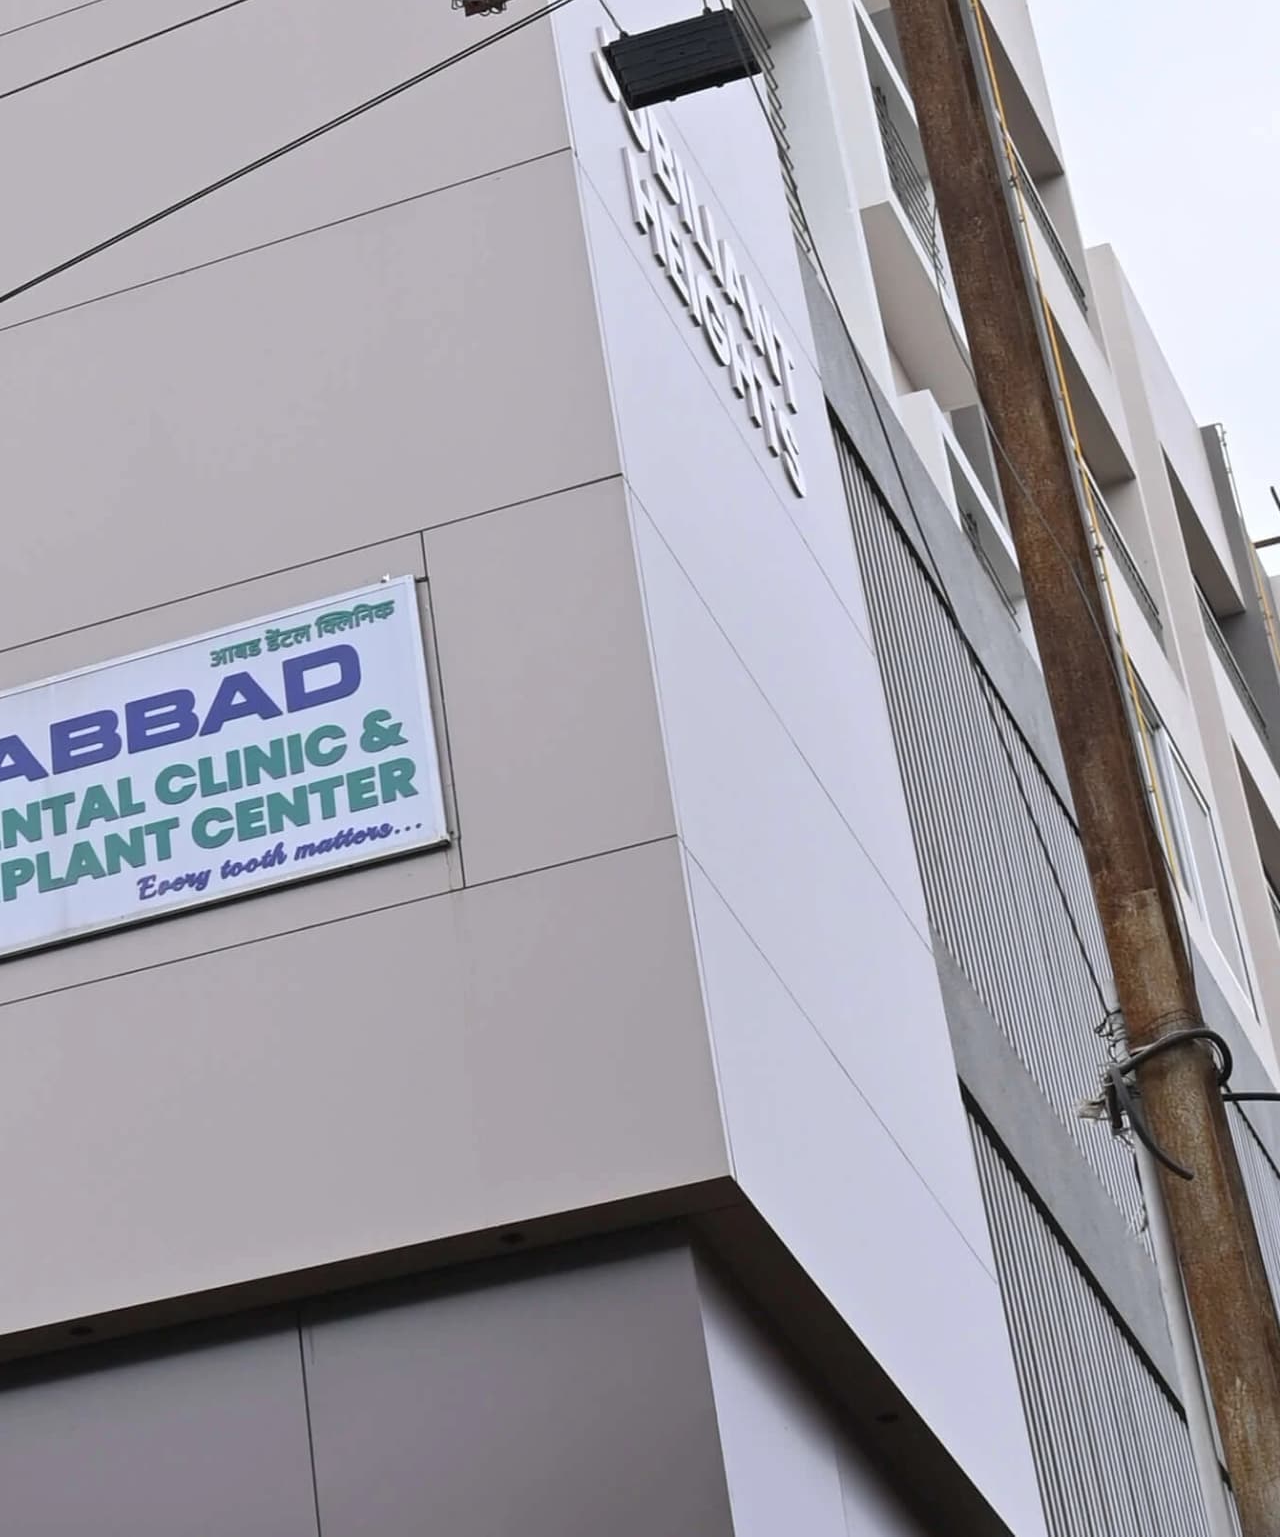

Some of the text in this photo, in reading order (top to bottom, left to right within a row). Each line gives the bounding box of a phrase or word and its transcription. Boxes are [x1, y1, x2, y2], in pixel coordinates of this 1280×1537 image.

[621, 146, 806, 498] HEIGHTS
[265, 624, 311, 653] डेंटल
[315, 599, 395, 639] क्लिनिक
[154, 723, 346, 805] CLINIC
[359, 708, 409, 753] &
[191, 756, 418, 850] CENTER
[137, 821, 423, 900] Every tooth matters...
